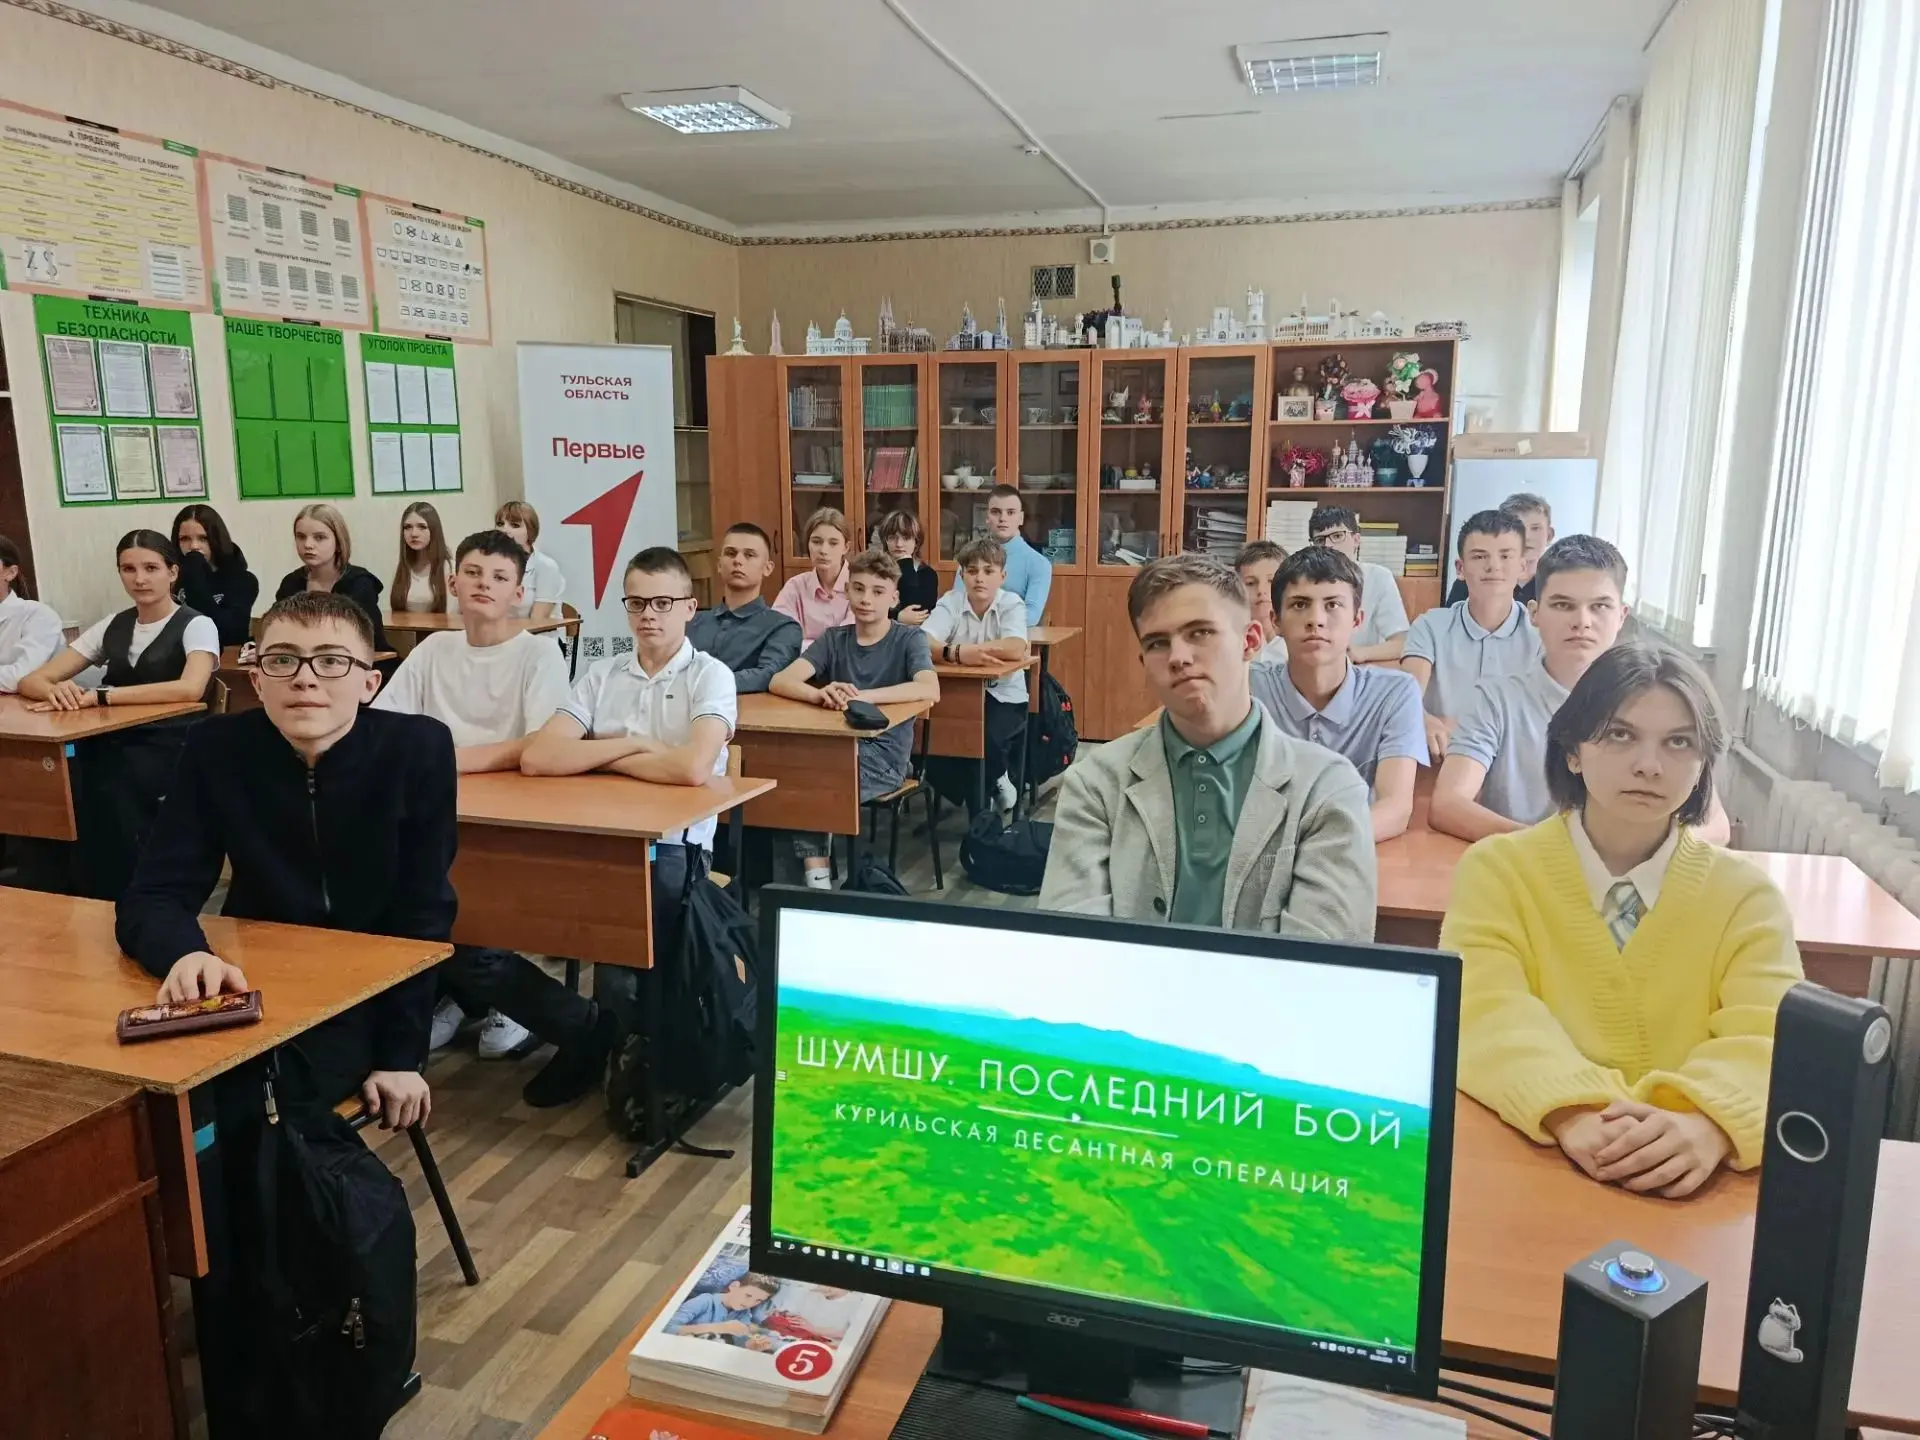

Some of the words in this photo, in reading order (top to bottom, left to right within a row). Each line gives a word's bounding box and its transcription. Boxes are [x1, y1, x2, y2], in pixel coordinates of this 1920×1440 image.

[77, 132, 120, 150] ПРЯДЕНИЕ
[82, 304, 150, 324] ТЕХНИКА
[57, 321, 177, 345] БЕЗОПАСНОСТИ
[225, 320, 264, 337] НАШЕ
[267, 325, 342, 345] ТВОРЧЕСТВО
[367, 337, 406, 353] УГОЛОК
[407, 342, 448, 356] ПРОЕКТА
[560, 374, 632, 387] ТУЛЬСКАЯ
[564, 389, 630, 400] ОБЛАСТЬ
[552, 437, 645, 464] Первые
[797, 1034, 955, 1087] ШУМШУ.
[980, 1058, 1264, 1130] ПОСЛЕДНИЙ
[1295, 1103, 1401, 1149] БОЙ
[835, 1102, 998, 1143] КУРИЛЬСКАЯ
[1014, 1128, 1174, 1170] ДЕСАНТНАЯ
[1192, 1156, 1349, 1199] ОПЕРАЦИЯ
[1047, 1312, 1086, 1327] acer
[788, 1349, 819, 1375] 5
